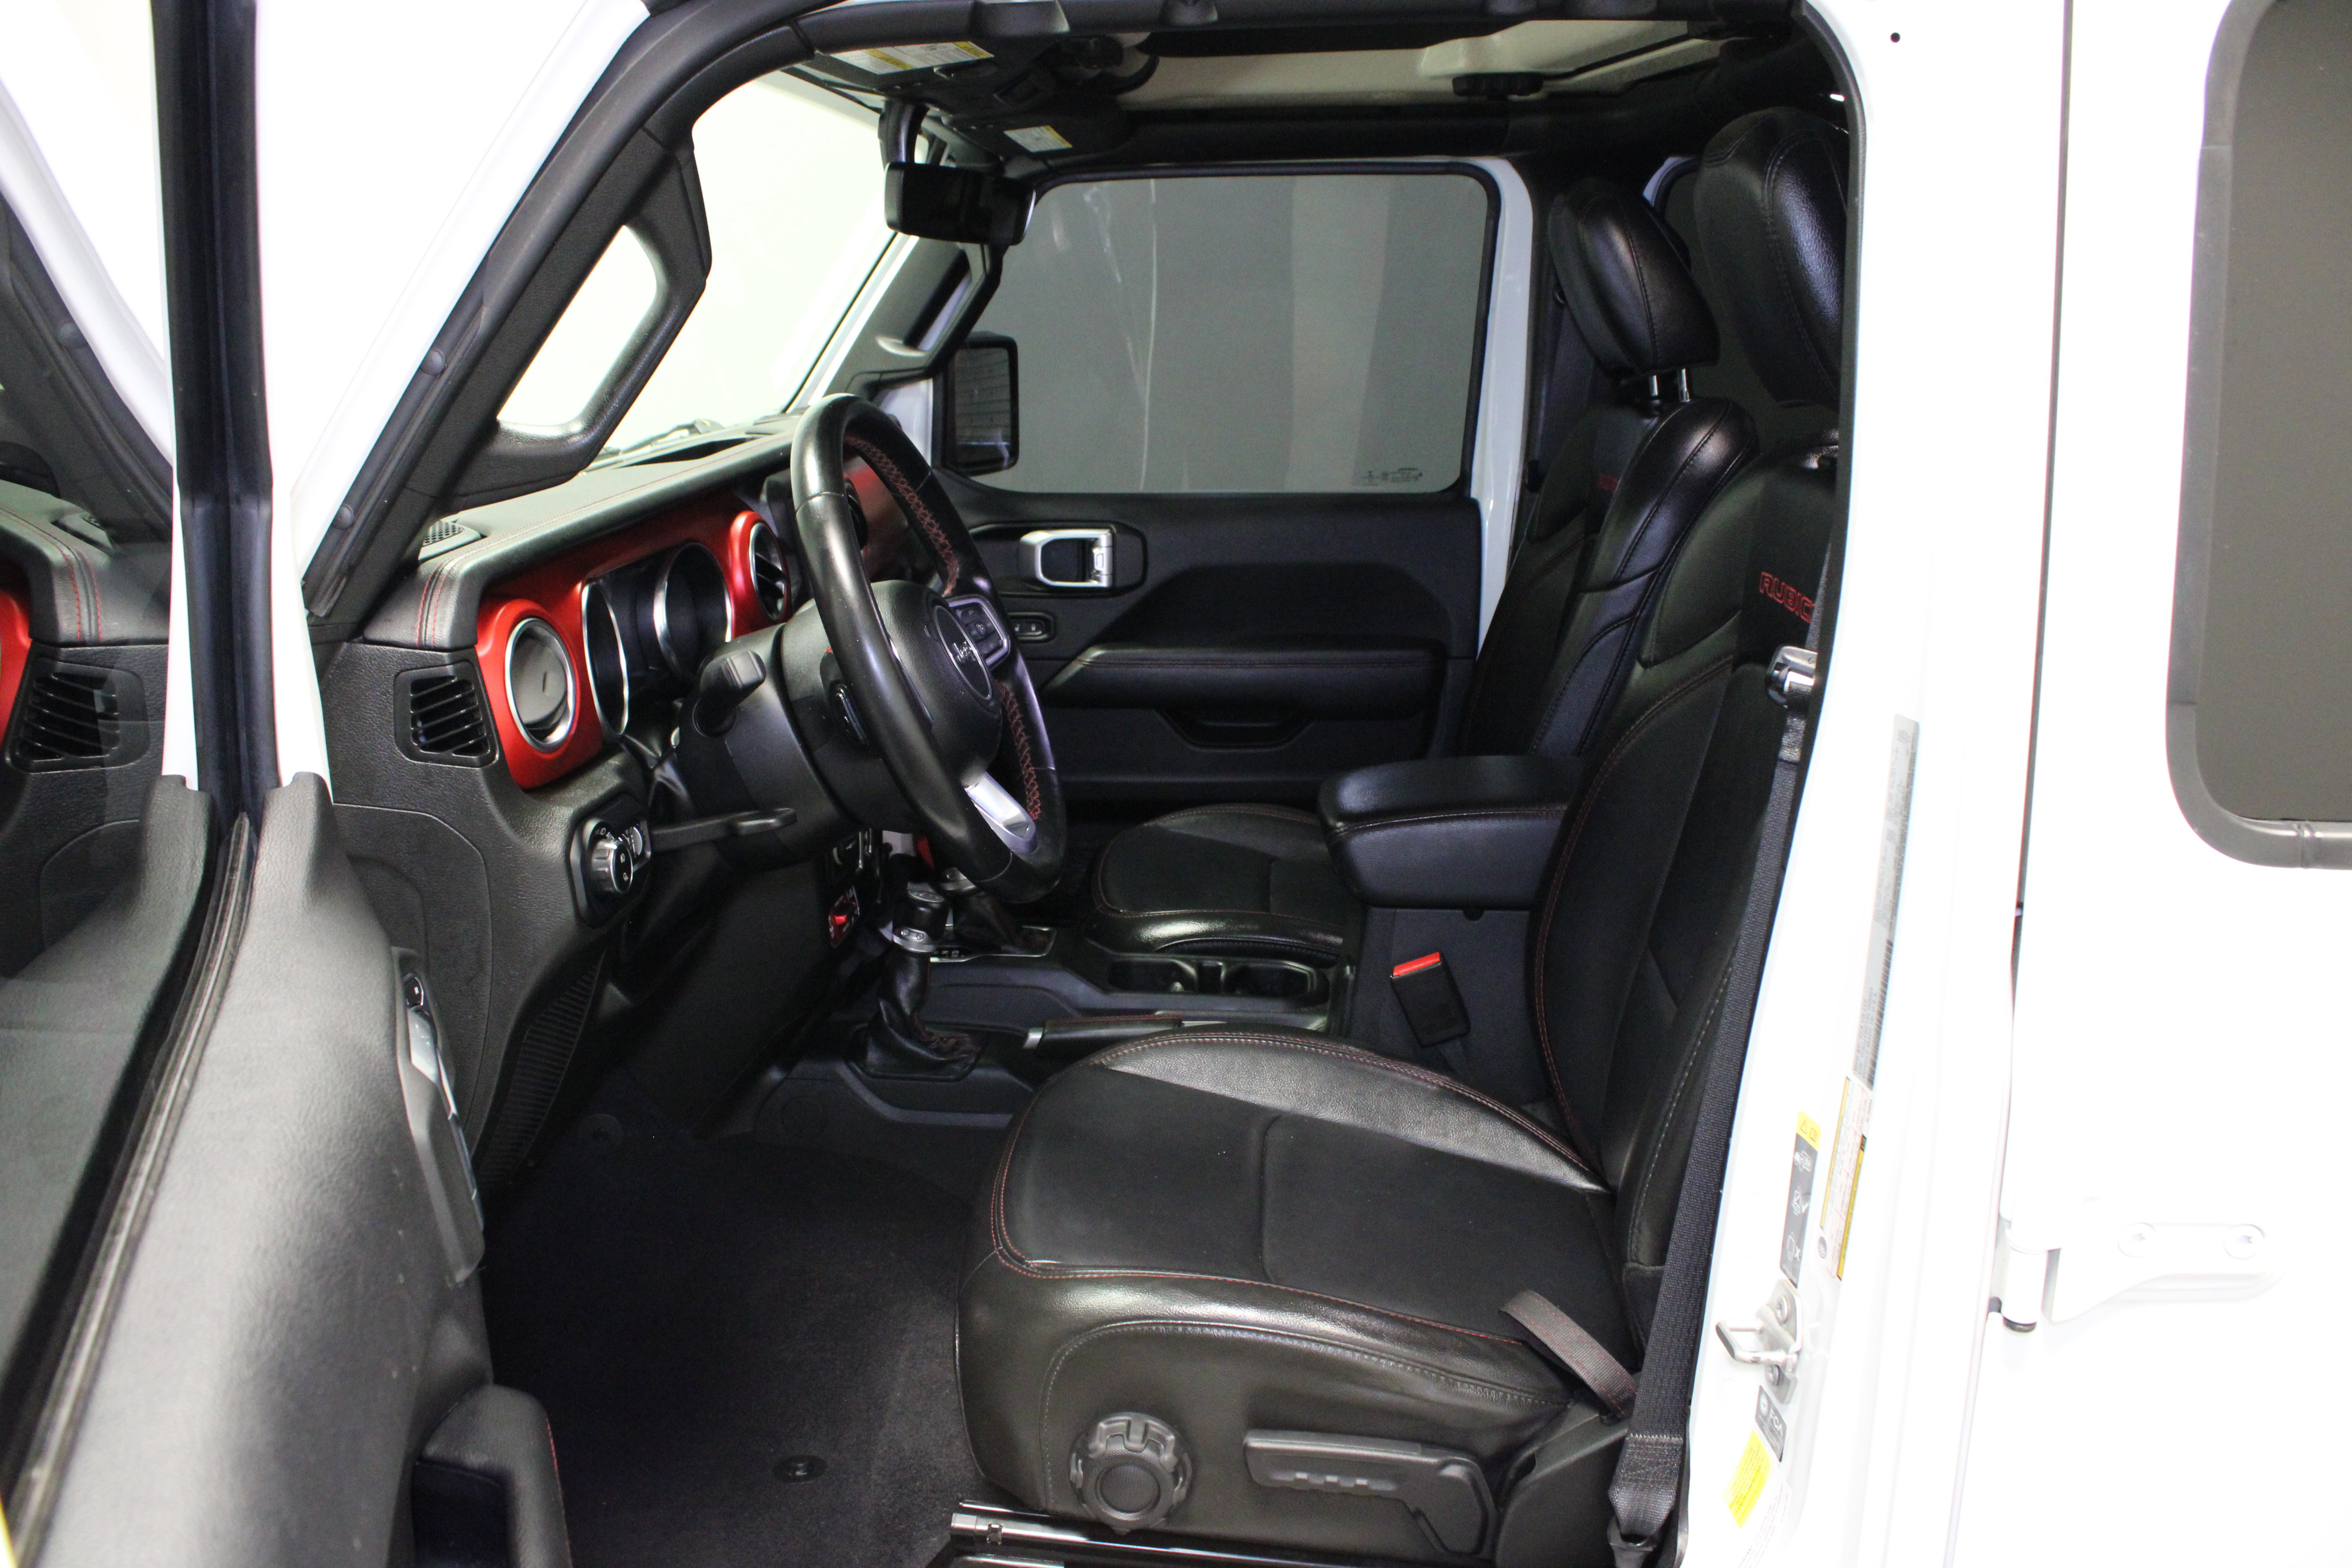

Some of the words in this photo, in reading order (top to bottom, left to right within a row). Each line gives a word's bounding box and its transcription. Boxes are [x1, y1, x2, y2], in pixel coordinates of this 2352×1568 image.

[1760, 572, 1816, 623] RUBIC
[414, 987, 419, 995] R
[1769, 1408, 1782, 1437] FCA
